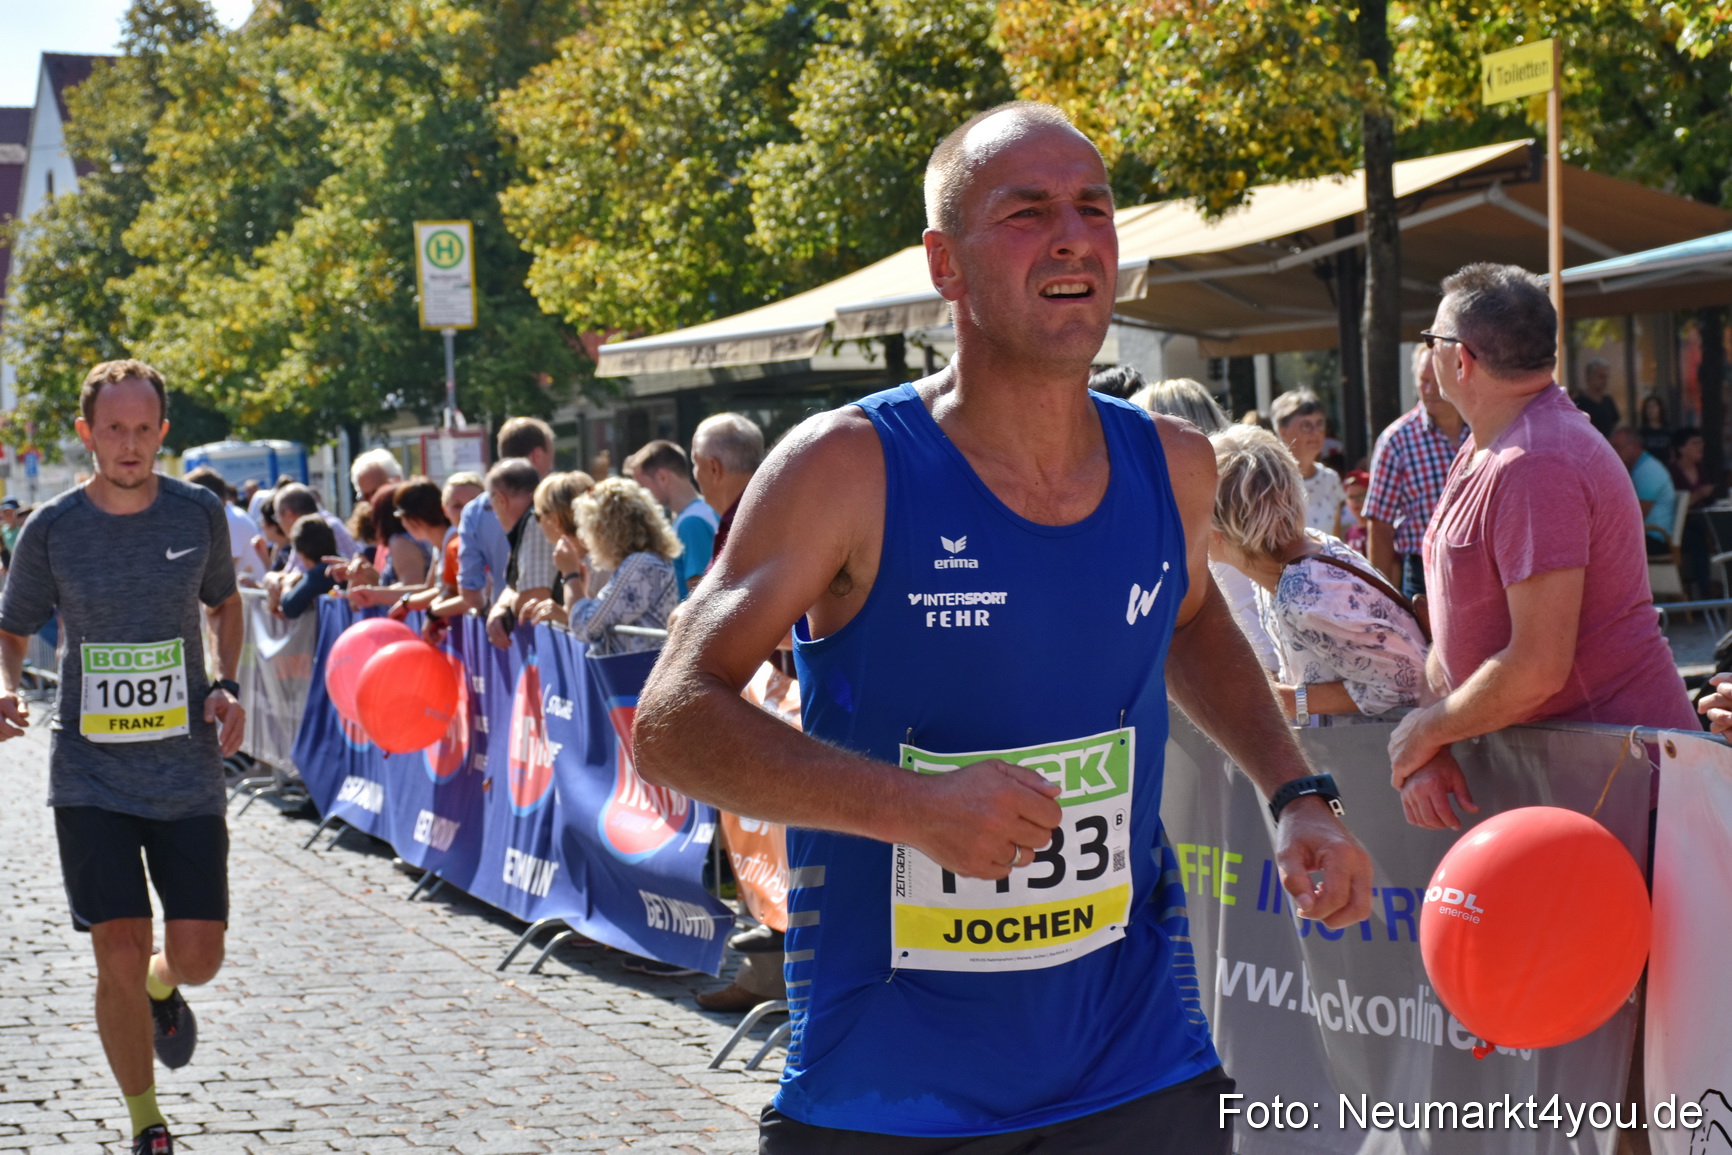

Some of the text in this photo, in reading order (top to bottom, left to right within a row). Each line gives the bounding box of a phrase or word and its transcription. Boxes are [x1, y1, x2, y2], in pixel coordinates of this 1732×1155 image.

[1496, 61, 1549, 85] Toiletten
[435, 240, 454, 260] H
[934, 556, 979, 570] erima
[923, 592, 1008, 606] INTERSPORT
[926, 609, 990, 628] FEHR
[89, 644, 177, 670] BOCK
[96, 675, 173, 708] 1087
[108, 716, 165, 731] FRANZ
[1115, 813, 1123, 826] B
[942, 815, 1111, 895] 33
[943, 904, 1095, 945] JOCHEN
